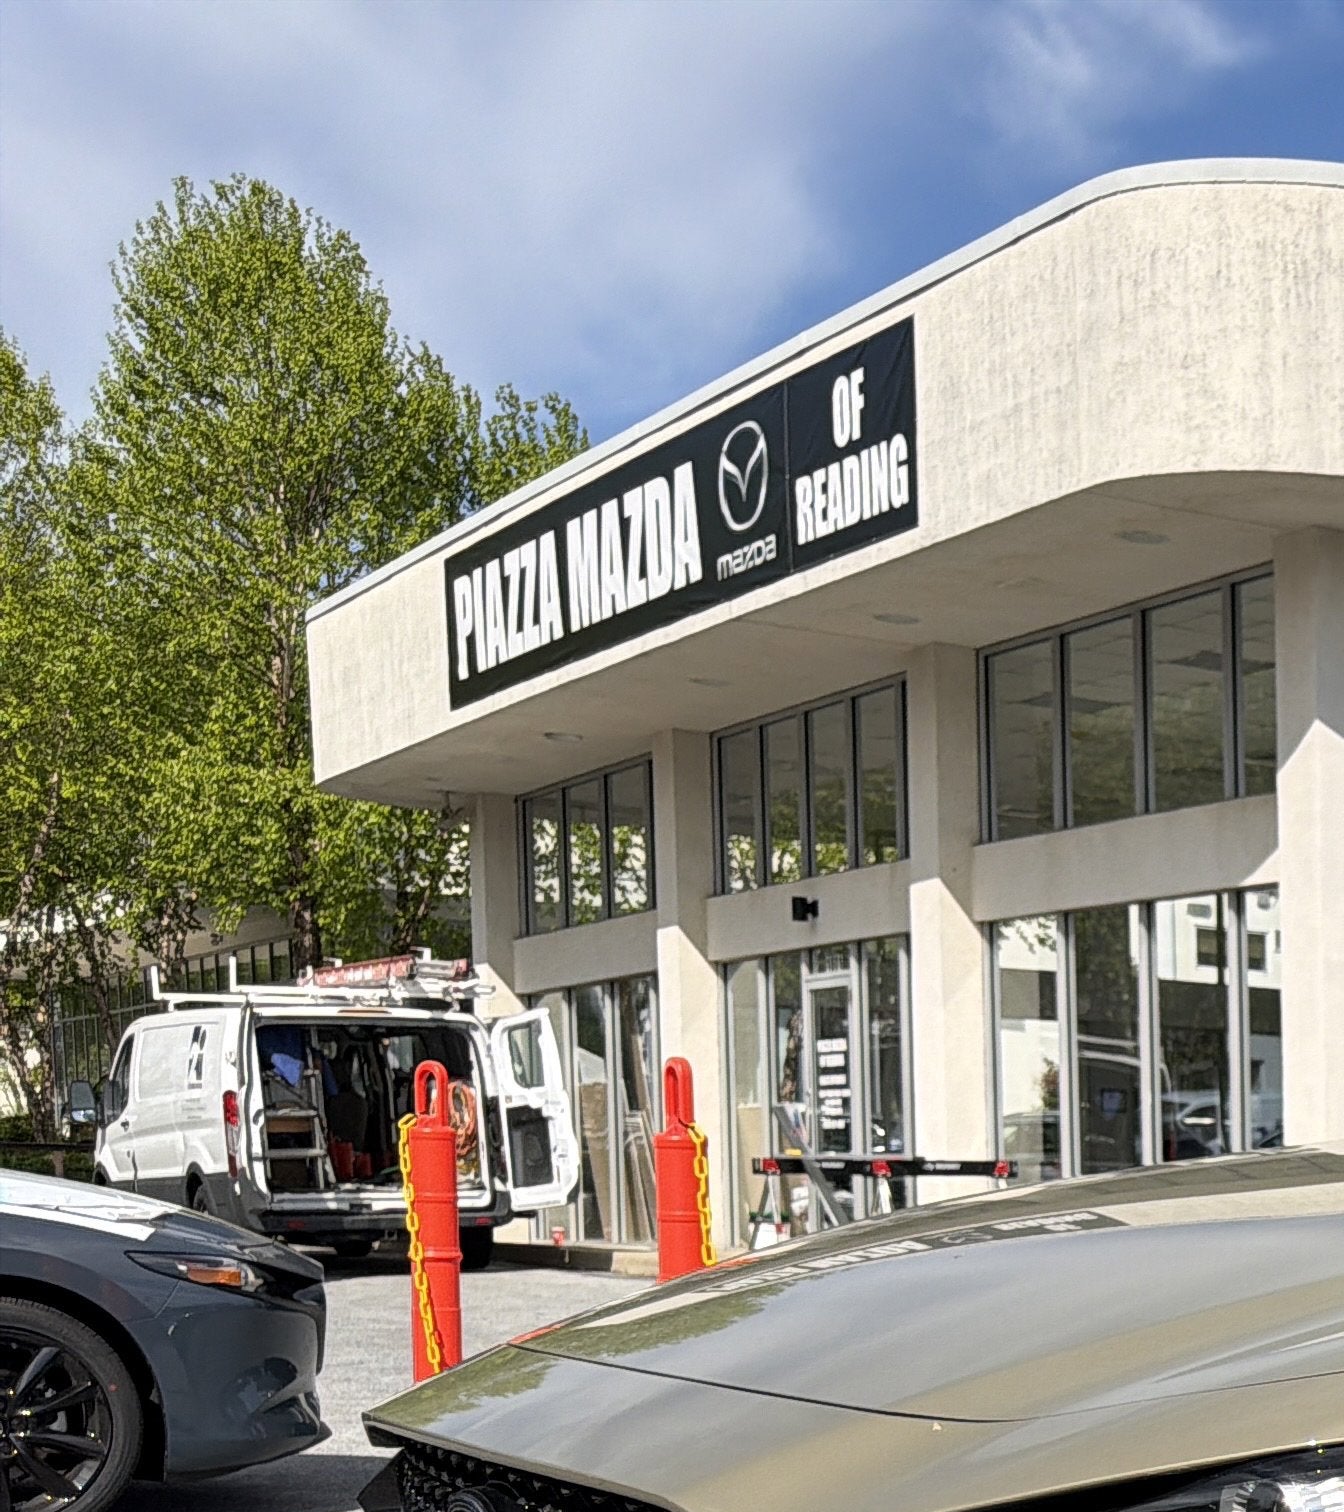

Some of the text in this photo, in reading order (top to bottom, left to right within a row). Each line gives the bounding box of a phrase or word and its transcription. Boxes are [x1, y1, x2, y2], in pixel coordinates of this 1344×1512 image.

[831, 367, 865, 448] OF
[794, 432, 910, 545] READING
[453, 459, 704, 682] PIAZZA MAZDA
[717, 533, 777, 582] mazda
